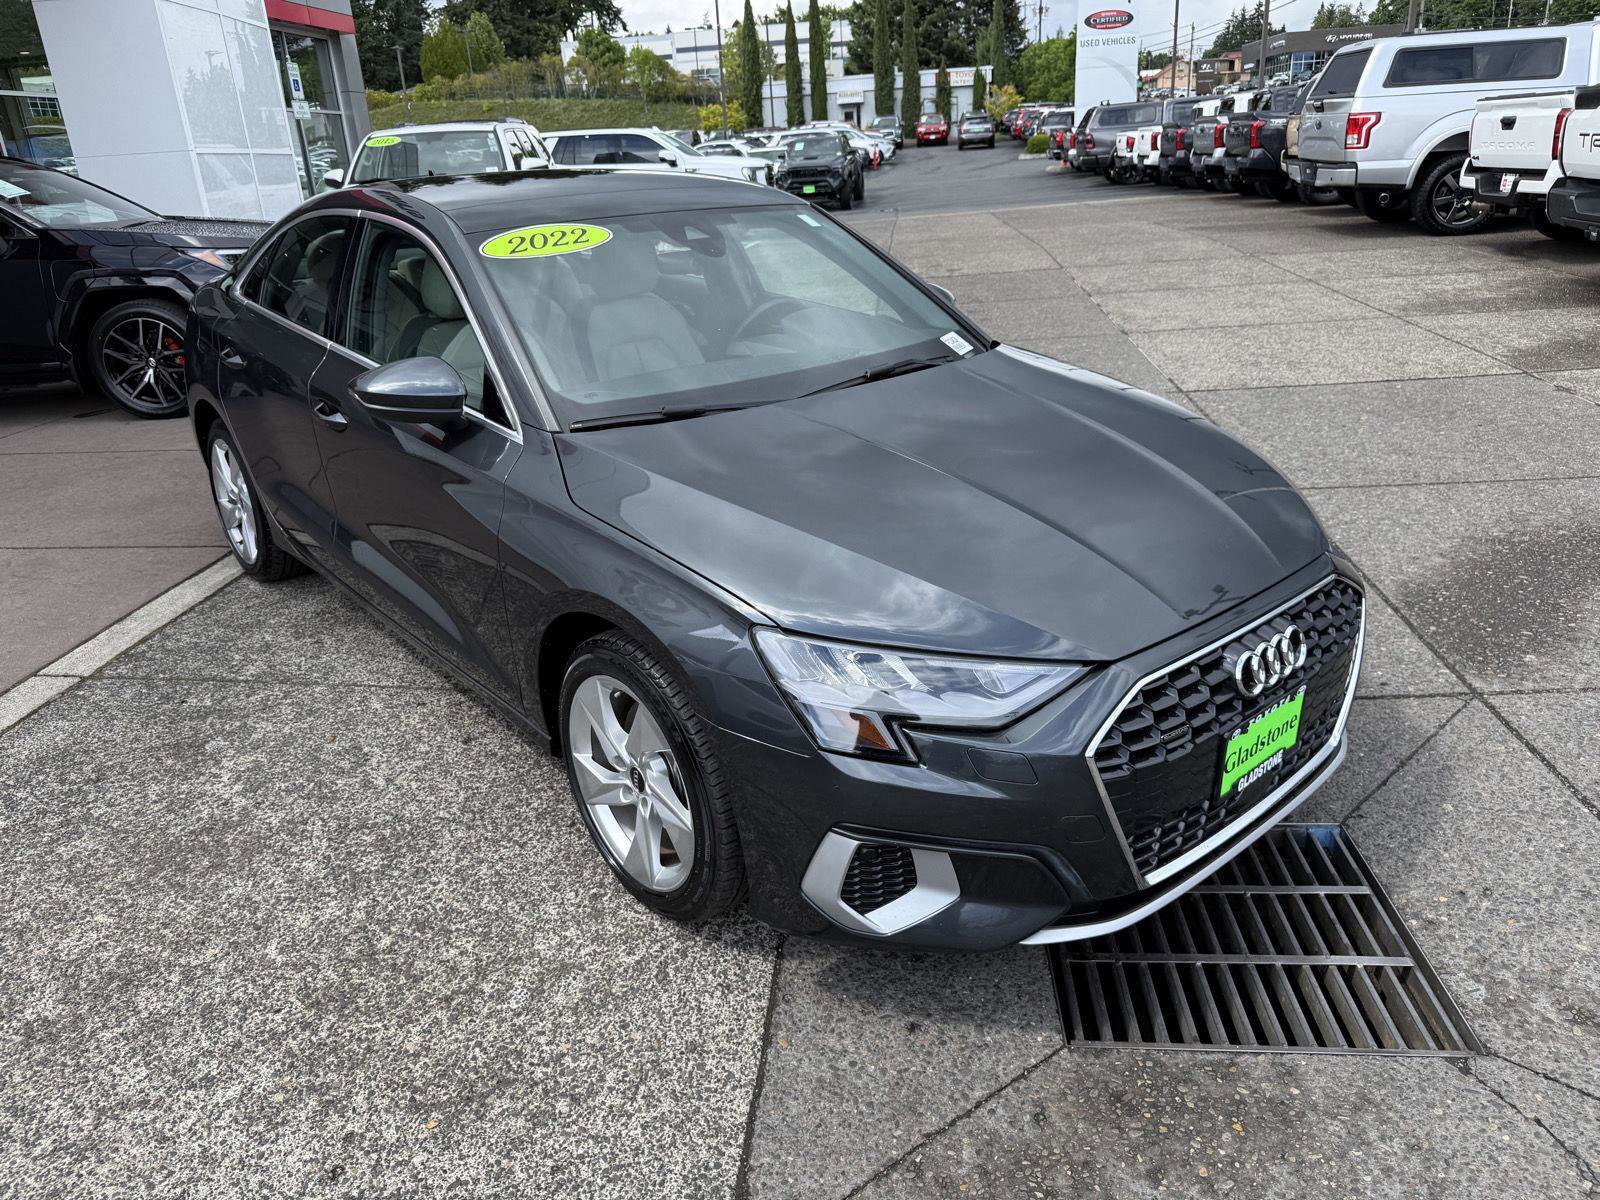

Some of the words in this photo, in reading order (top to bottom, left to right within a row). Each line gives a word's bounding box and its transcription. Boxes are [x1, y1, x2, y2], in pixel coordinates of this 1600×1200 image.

[1090, 16, 1128, 24] CERTIFIED
[1080, 39, 1100, 48] USED
[1101, 36, 1137, 46] VEHICLES
[507, 228, 590, 255] 2022
[1225, 714, 1298, 774] Gladstone
[1238, 749, 1285, 792] GLADSTONE
